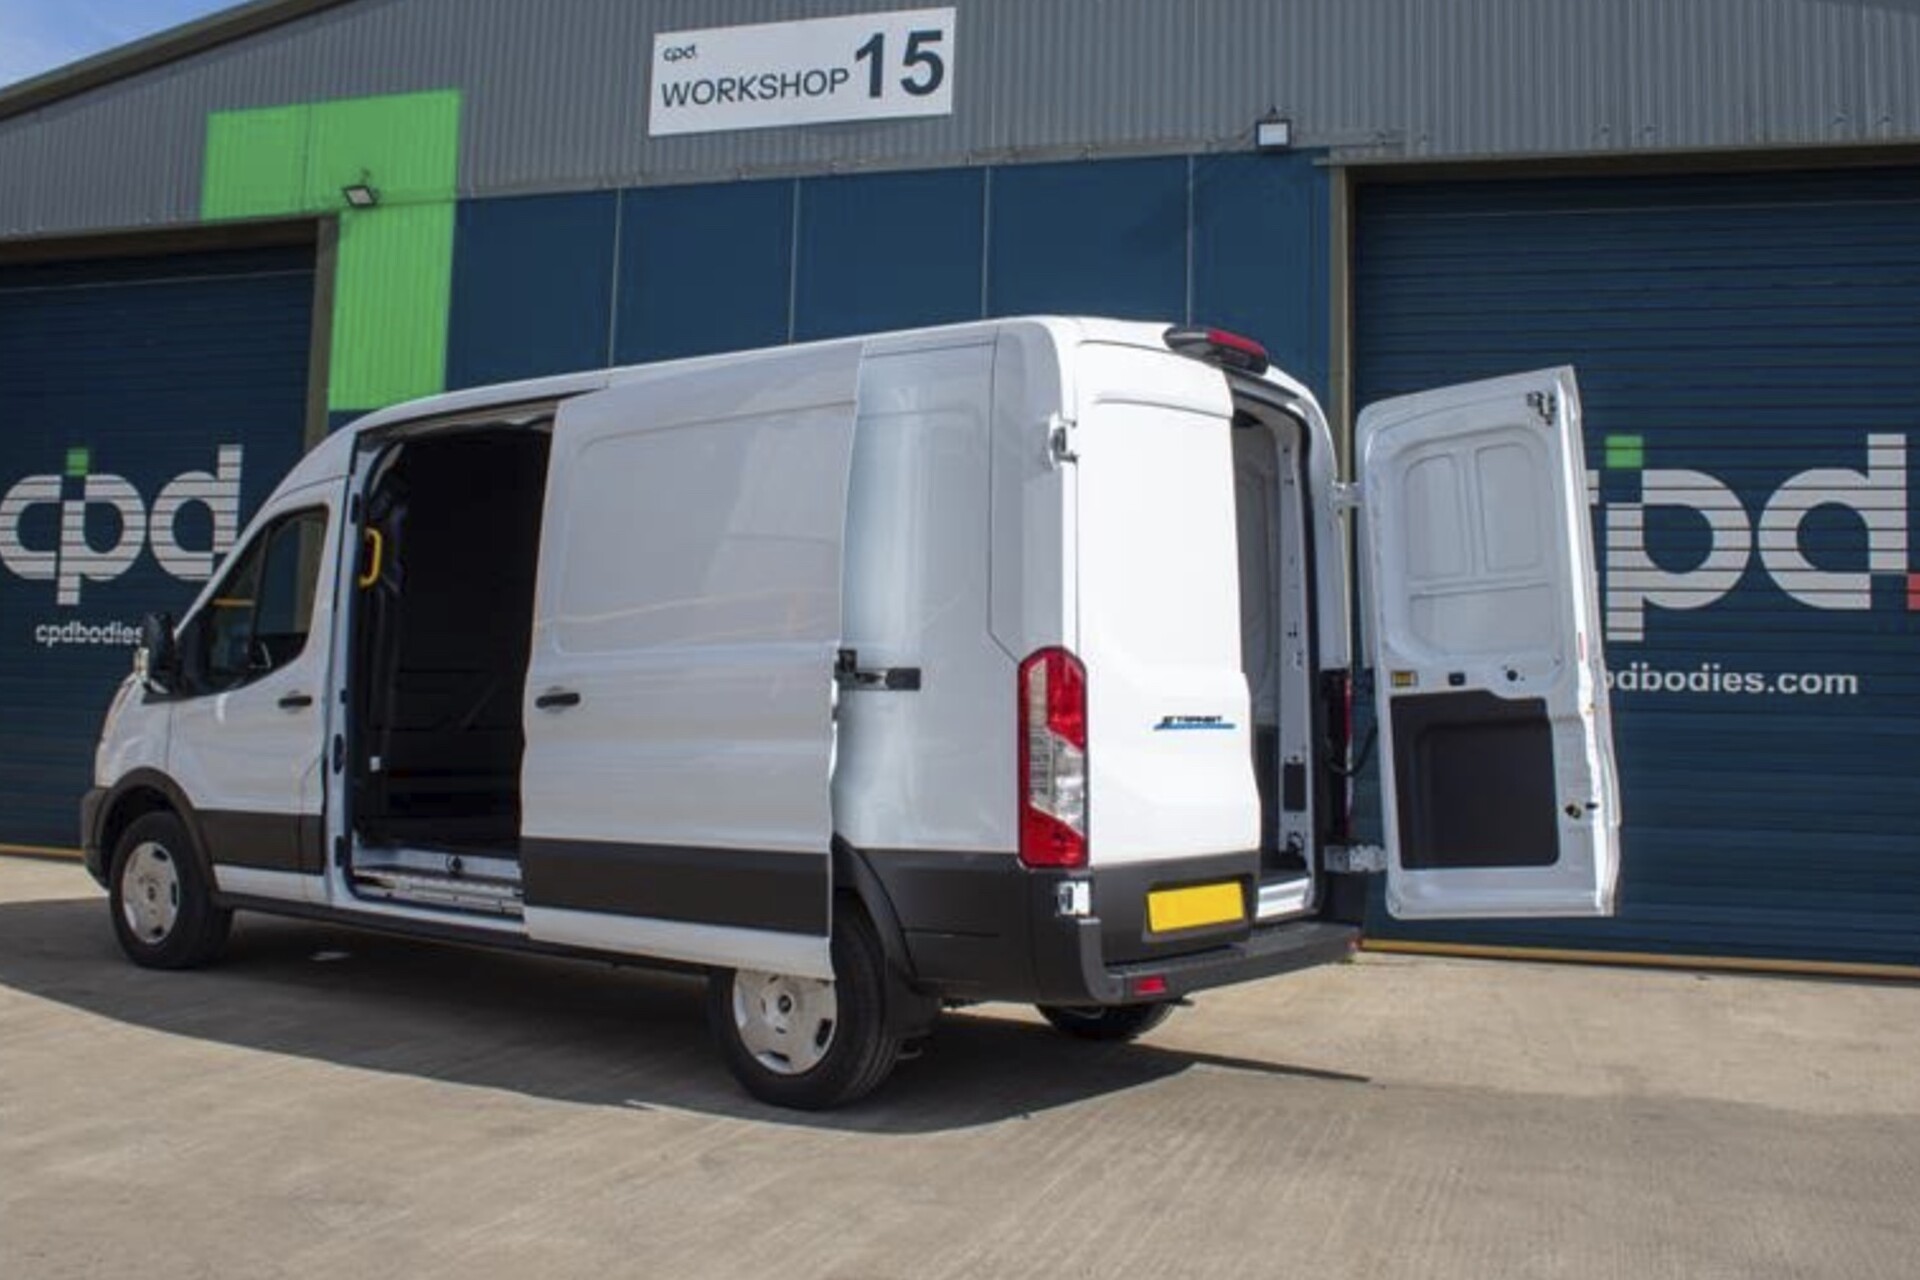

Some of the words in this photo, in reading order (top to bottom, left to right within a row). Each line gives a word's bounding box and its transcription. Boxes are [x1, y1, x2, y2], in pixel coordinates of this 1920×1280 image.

[661, 68, 850, 107] WORKSHOP
[855, 30, 944, 98] 15
[0, 444, 243, 605] cpd
[1588, 433, 1908, 642] pd
